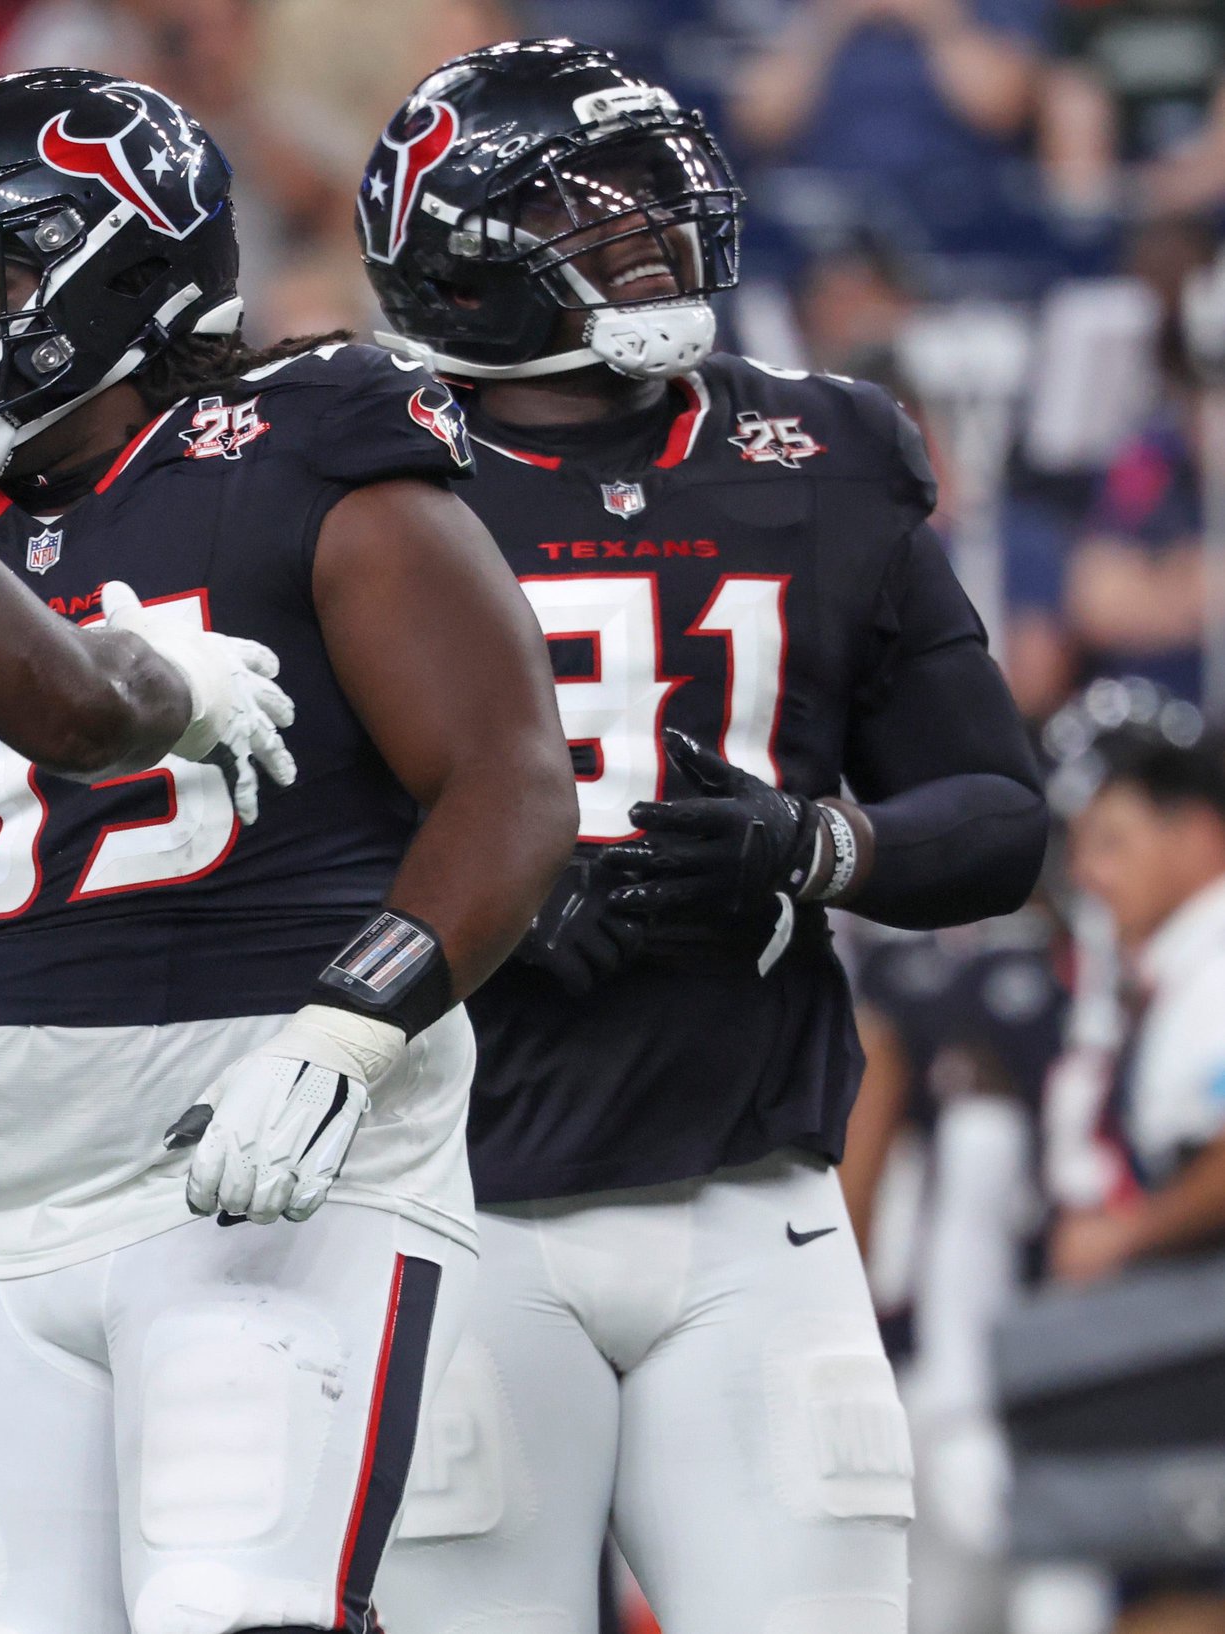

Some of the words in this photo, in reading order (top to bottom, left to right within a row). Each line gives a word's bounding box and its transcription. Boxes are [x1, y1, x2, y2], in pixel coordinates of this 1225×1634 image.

[192, 393, 261, 445] 25
[737, 416, 816, 451] 25
[610, 494, 637, 510] NFL
[32, 548, 55, 566] NFL
[537, 538, 720, 561] TEXANS
